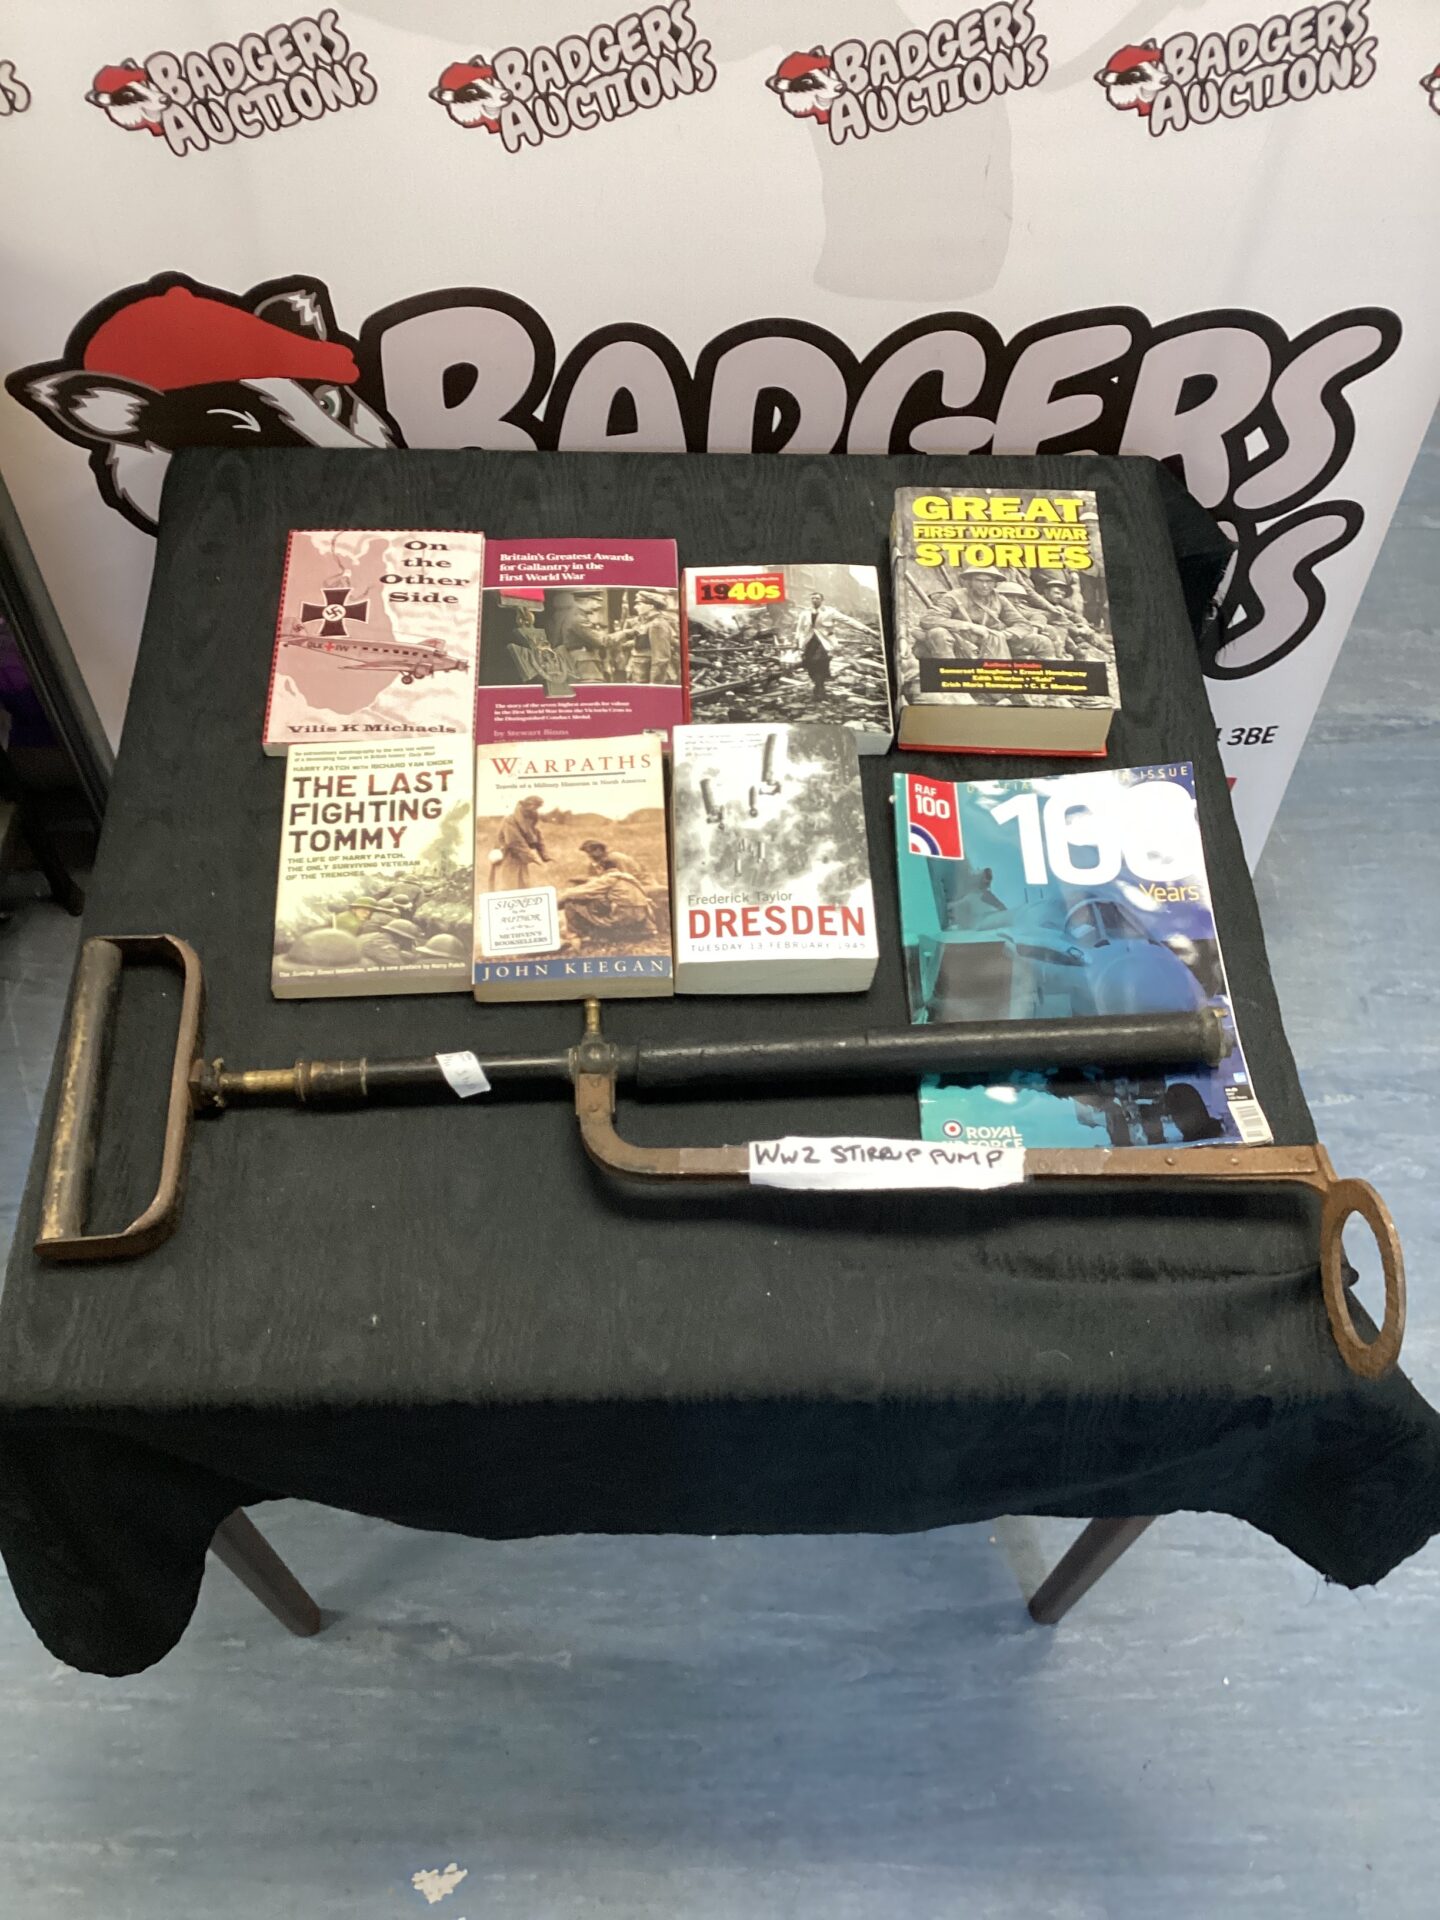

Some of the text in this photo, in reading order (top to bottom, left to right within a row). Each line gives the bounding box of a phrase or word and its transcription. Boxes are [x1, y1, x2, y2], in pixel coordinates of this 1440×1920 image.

[492, 0, 696, 102] BADGERS
[831, 0, 1035, 95] BADGERS
[1162, 0, 1370, 87] BADGERS
[144, 8, 350, 107] BADGERS
[500, 39, 717, 154] AUCTIONS
[828, 34, 1049, 146] AUCTIONS
[1148, 36, 1379, 137] AUCTIONS
[161, 51, 378, 157] AUCTIONS
[911, 496, 1084, 523] GREAT
[913, 525, 1089, 542] FIRST WORLD WAR
[404, 540, 449, 551] On
[402, 558, 452, 568] the
[499, 562, 604, 572] for Gallantry in the
[500, 553, 634, 561] Britain's Greatest Awards
[915, 543, 1094, 570] STORIES
[379, 574, 471, 587] Other
[499, 572, 586, 581] First World War
[388, 592, 459, 604] Side
[701, 581, 781, 601] 1940s
[287, 724, 457, 734] Vilis K Michaels
[1226, 725, 1279, 746] 3BE
[1139, 765, 1189, 780] ISSUE
[292, 769, 454, 798] THE LAST
[914, 783, 938, 797] RAF
[289, 798, 442, 826] FIGHTING
[915, 795, 951, 820] 100
[289, 826, 407, 853] TOMMY
[688, 891, 793, 906] Frederick Taylor
[1139, 882, 1201, 903] Years
[688, 904, 866, 940] DRESDEN
[691, 943, 743, 952] TUESDAY
[482, 959, 666, 981] JOHN KEEGAN
[965, 1125, 1023, 1139] ROYAL
[930, 1149, 1005, 1168] PUMP
